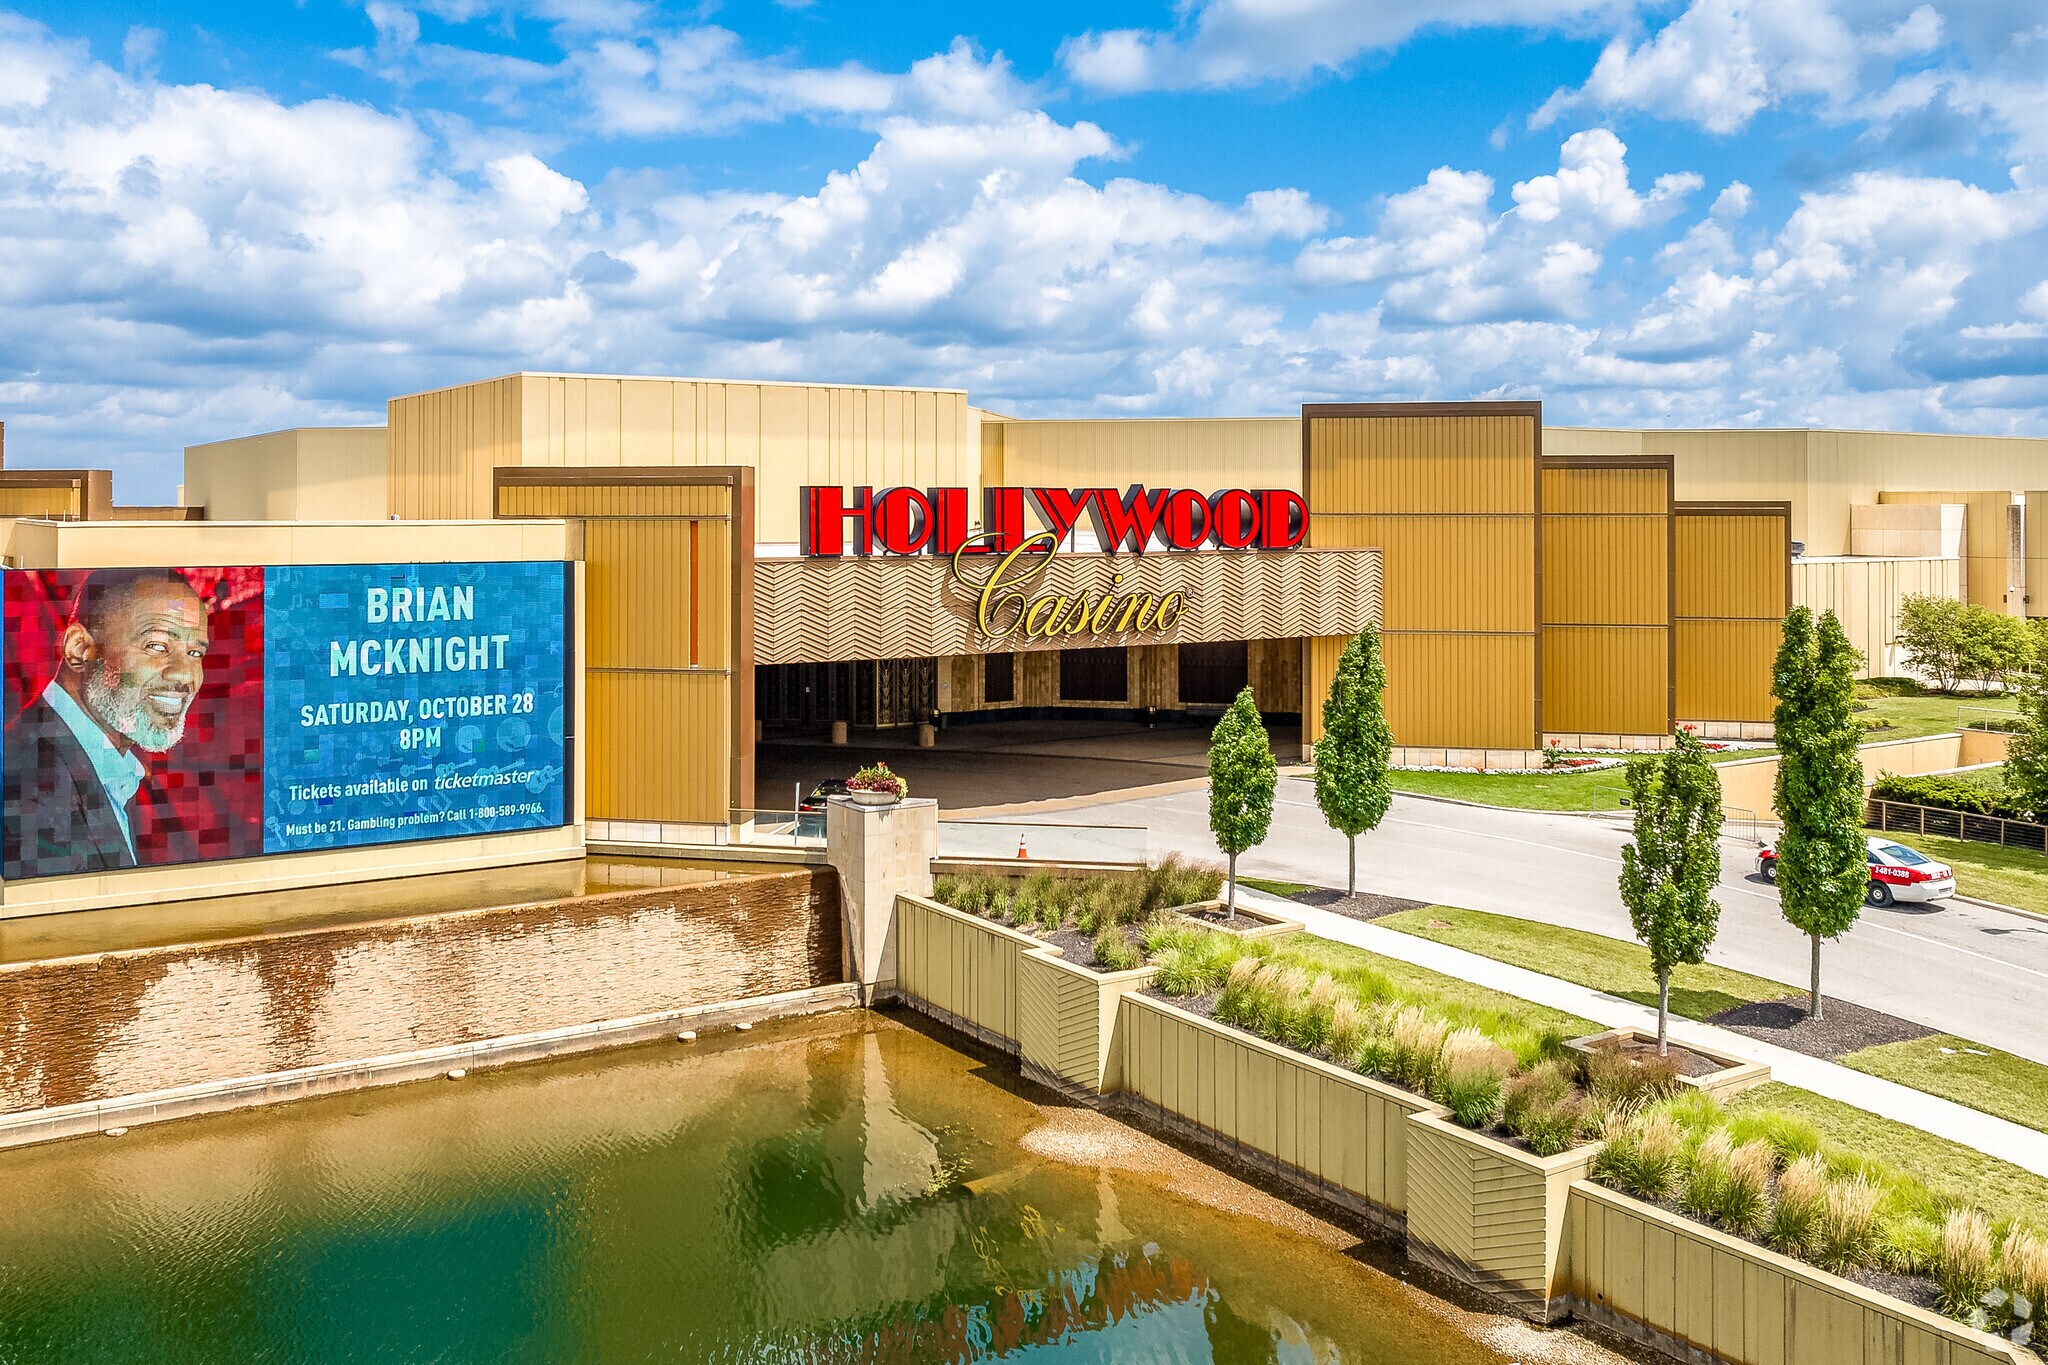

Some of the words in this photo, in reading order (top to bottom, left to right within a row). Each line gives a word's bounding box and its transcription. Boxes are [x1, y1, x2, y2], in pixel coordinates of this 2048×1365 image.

[800, 483, 1310, 556] HOLLYWOOD
[952, 532, 1189, 639] Casino
[367, 585, 474, 623] BRIAN
[330, 634, 510, 677] MCKNIGHT
[300, 699, 414, 727] SATURDAY,
[419, 695, 506, 719] OCTOBER
[512, 692, 534, 714] 28
[399, 726, 442, 750] 8PM
[289, 783, 342, 801] Tickets
[345, 777, 408, 796] available
[411, 777, 428, 792] on
[434, 770, 533, 790] ticketmaster
[286, 823, 313, 836] Must
[314, 820, 327, 834] be
[329, 818, 346, 833] 21.
[347, 812, 396, 833] Gambling
[397, 813, 445, 830] problem?
[447, 808, 467, 822] Call
[468, 801, 546, 820] 1-800-589-9966.
